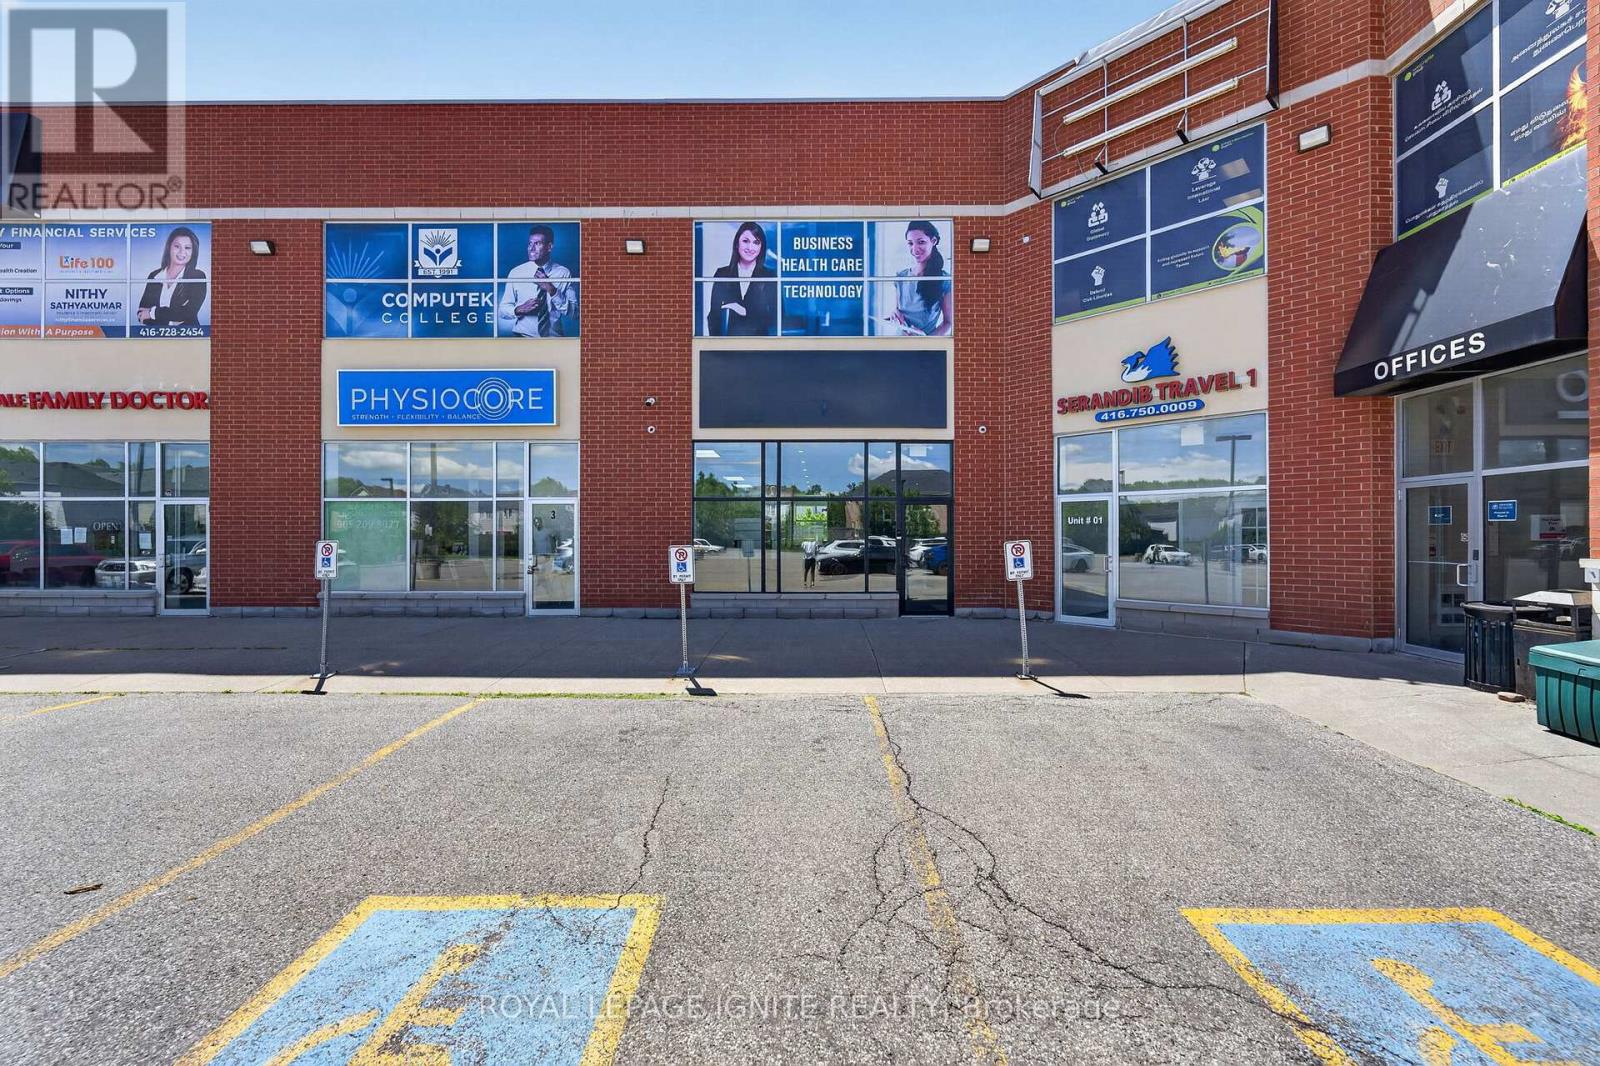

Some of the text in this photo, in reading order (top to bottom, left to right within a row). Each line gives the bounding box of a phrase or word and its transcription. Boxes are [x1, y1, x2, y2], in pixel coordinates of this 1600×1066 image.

[11, 228, 84, 238] FINANCIAL
[90, 228, 156, 238] SERVICES
[793, 237, 854, 250] BUSINESS
[59, 256, 115, 269] Life 100
[782, 258, 863, 272] HEALTH CARE
[65, 288, 108, 300] NITHY
[783, 285, 863, 298] TECHNOLOGY
[50, 302, 122, 310] SATHYAKUMAR
[381, 292, 493, 308] COMPUTEK
[381, 312, 494, 324] COLLEGE
[18, 327, 42, 336] With
[46, 328, 53, 336] A
[55, 328, 95, 338] Purpose
[139, 328, 204, 337] 416-728-2454
[1373, 332, 1486, 381] OFFICES
[1057, 368, 1258, 415] SERANDIB TRAVEL 1
[28, 391, 106, 410] FAMILY
[110, 391, 209, 410] DOCTOR
[351, 388, 544, 411] PHYSIOCORE
[1100, 400, 1197, 421] 416.750.0009
[550, 510, 556, 519] 3
[1067, 516, 1084, 525] Unit
[1093, 516, 1103, 525] 01
